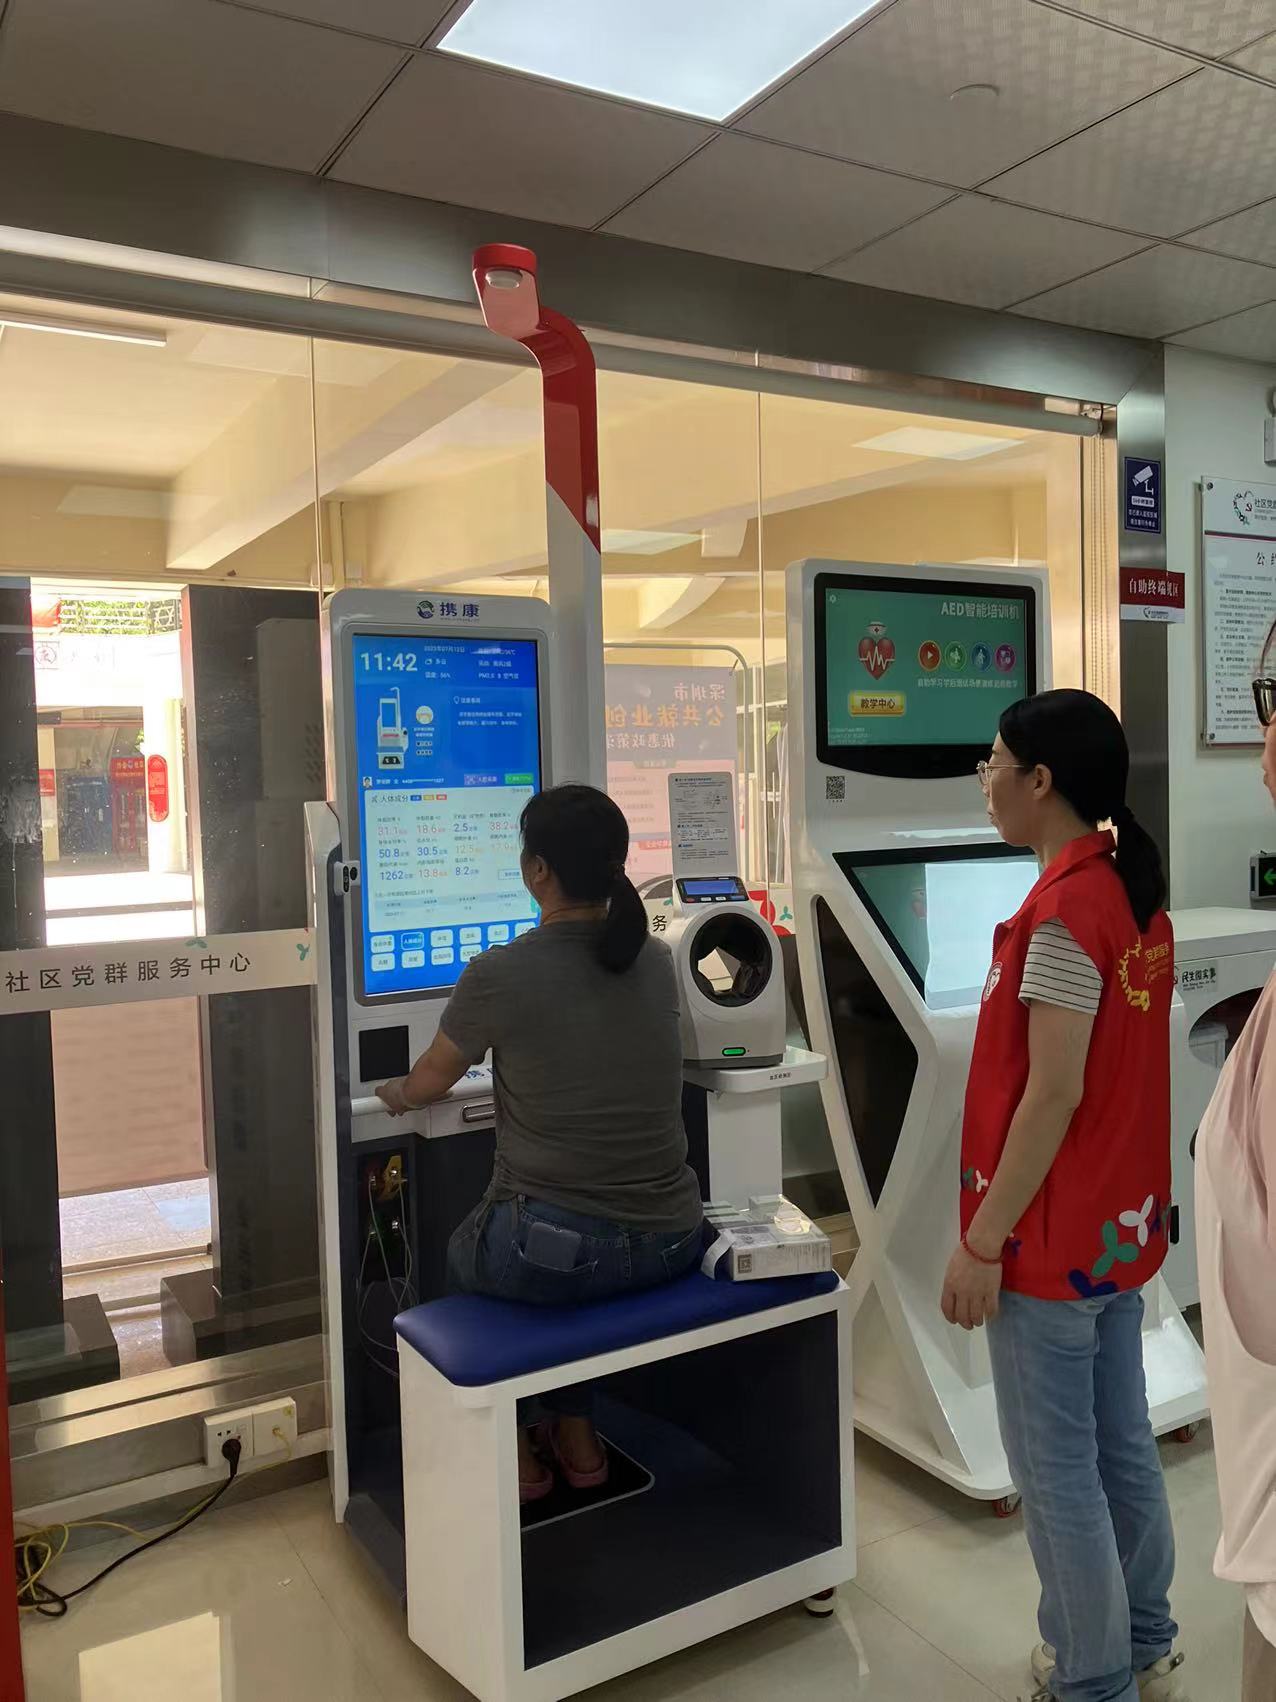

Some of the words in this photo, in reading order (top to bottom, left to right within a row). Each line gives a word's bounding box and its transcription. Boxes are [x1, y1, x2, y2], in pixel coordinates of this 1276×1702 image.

[440, 602, 480, 618] 携康
[941, 602, 1020, 619] AED智能培训机
[361, 652, 418, 672] 11:42
[860, 698, 896, 710] 教学中心
[652, 914, 668, 938] 务
[5, 952, 251, 994] 社区党群服务中心
